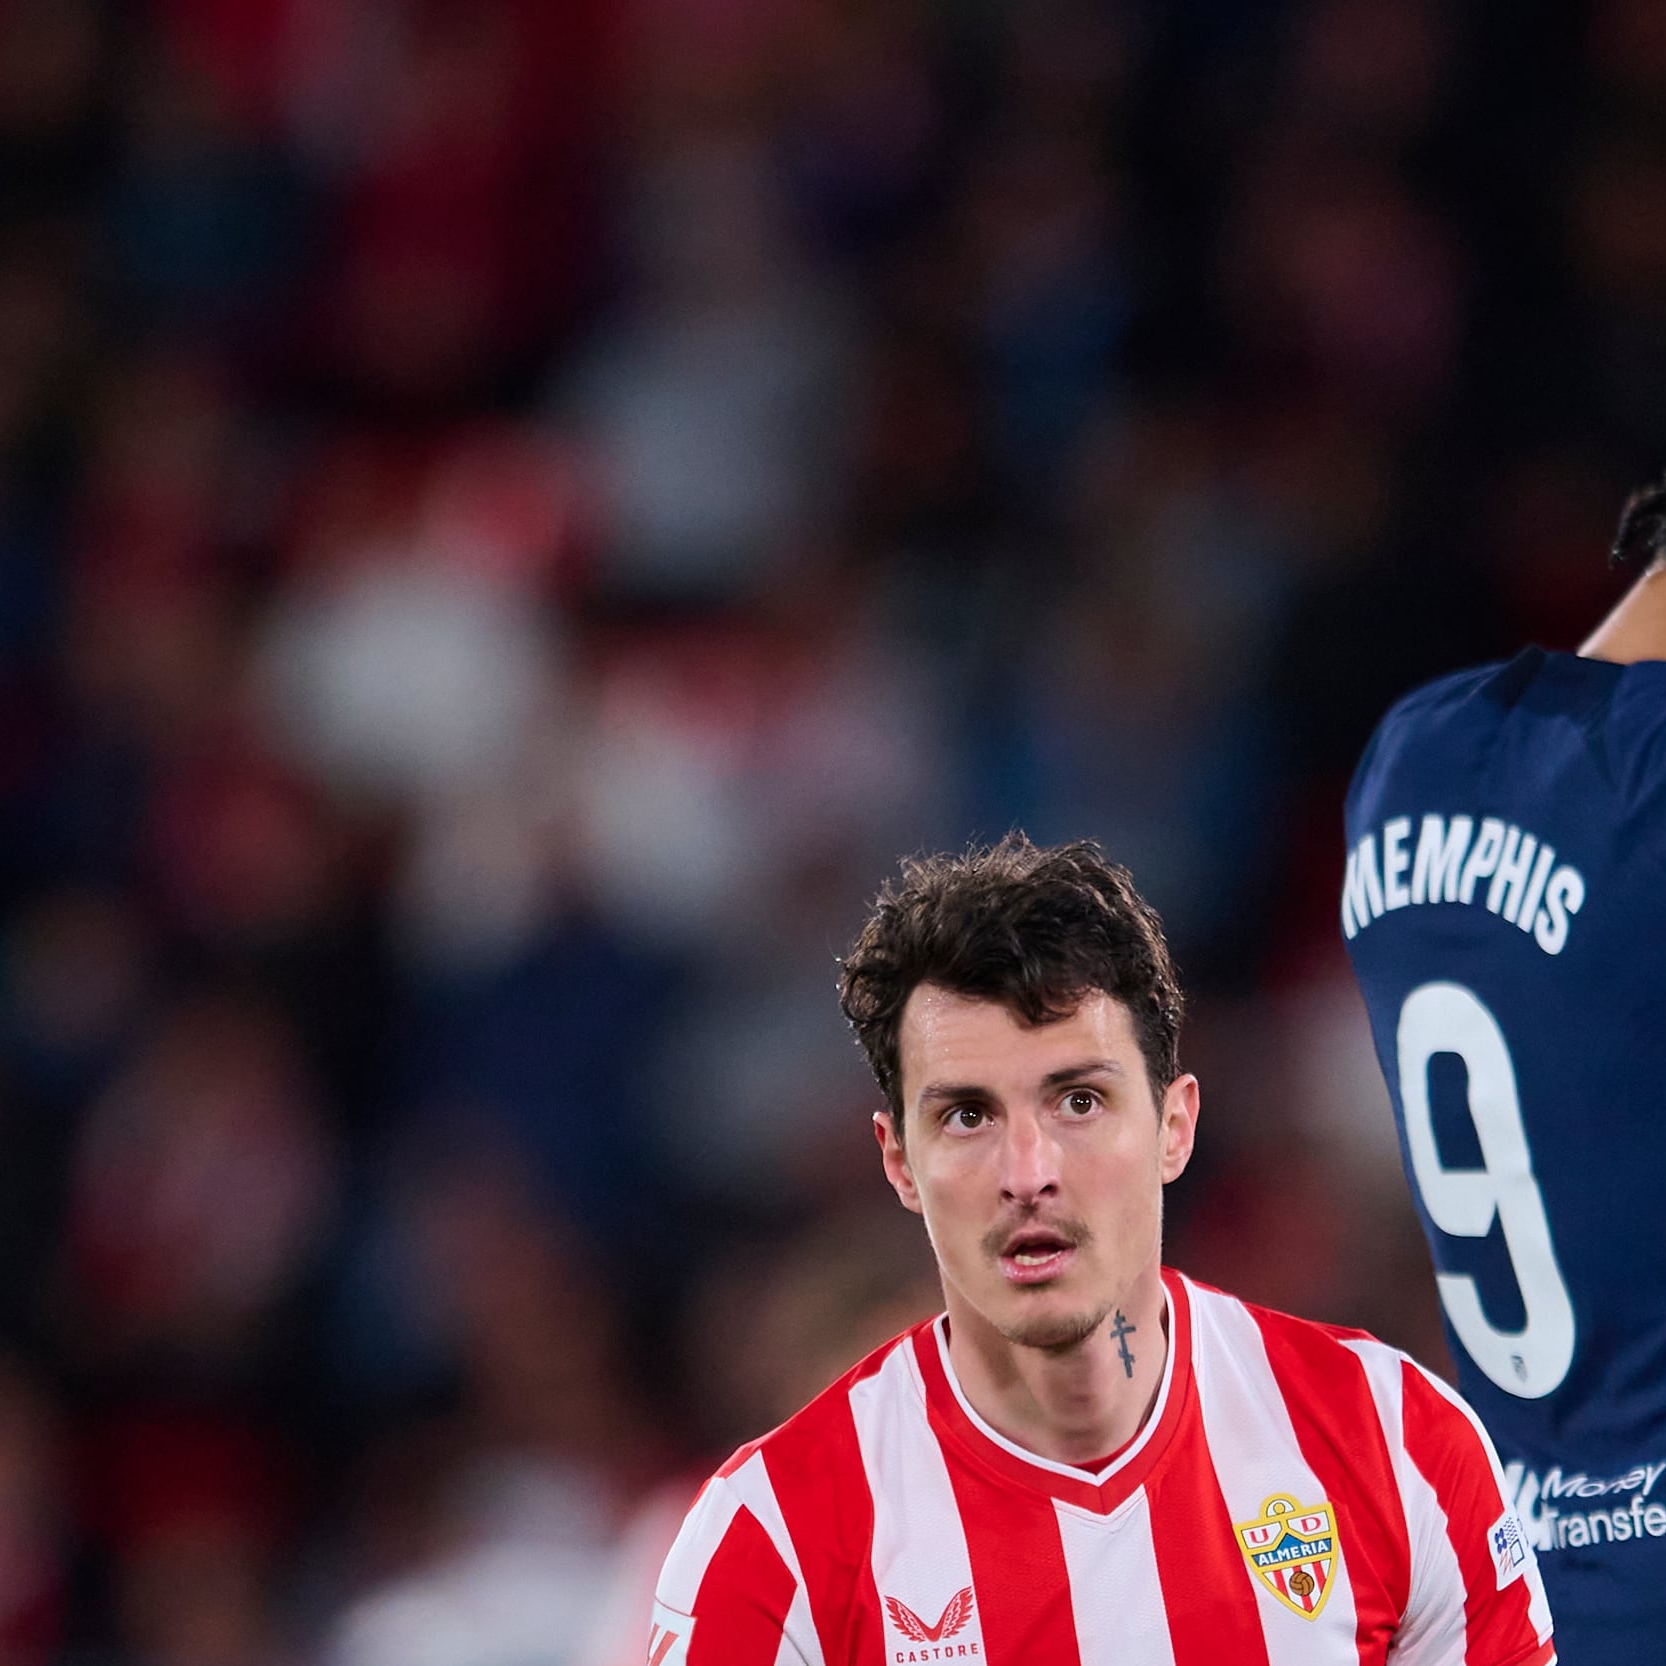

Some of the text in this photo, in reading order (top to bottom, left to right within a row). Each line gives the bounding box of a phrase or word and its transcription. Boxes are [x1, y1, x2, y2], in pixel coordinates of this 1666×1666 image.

[1341, 813, 1585, 956] MEMPHIS
[1396, 980, 1577, 1400] 9
[1249, 1516, 1322, 1544] U D
[1257, 1540, 1329, 1567] ALMERIA
[895, 1643, 979, 1664] CASTORE
